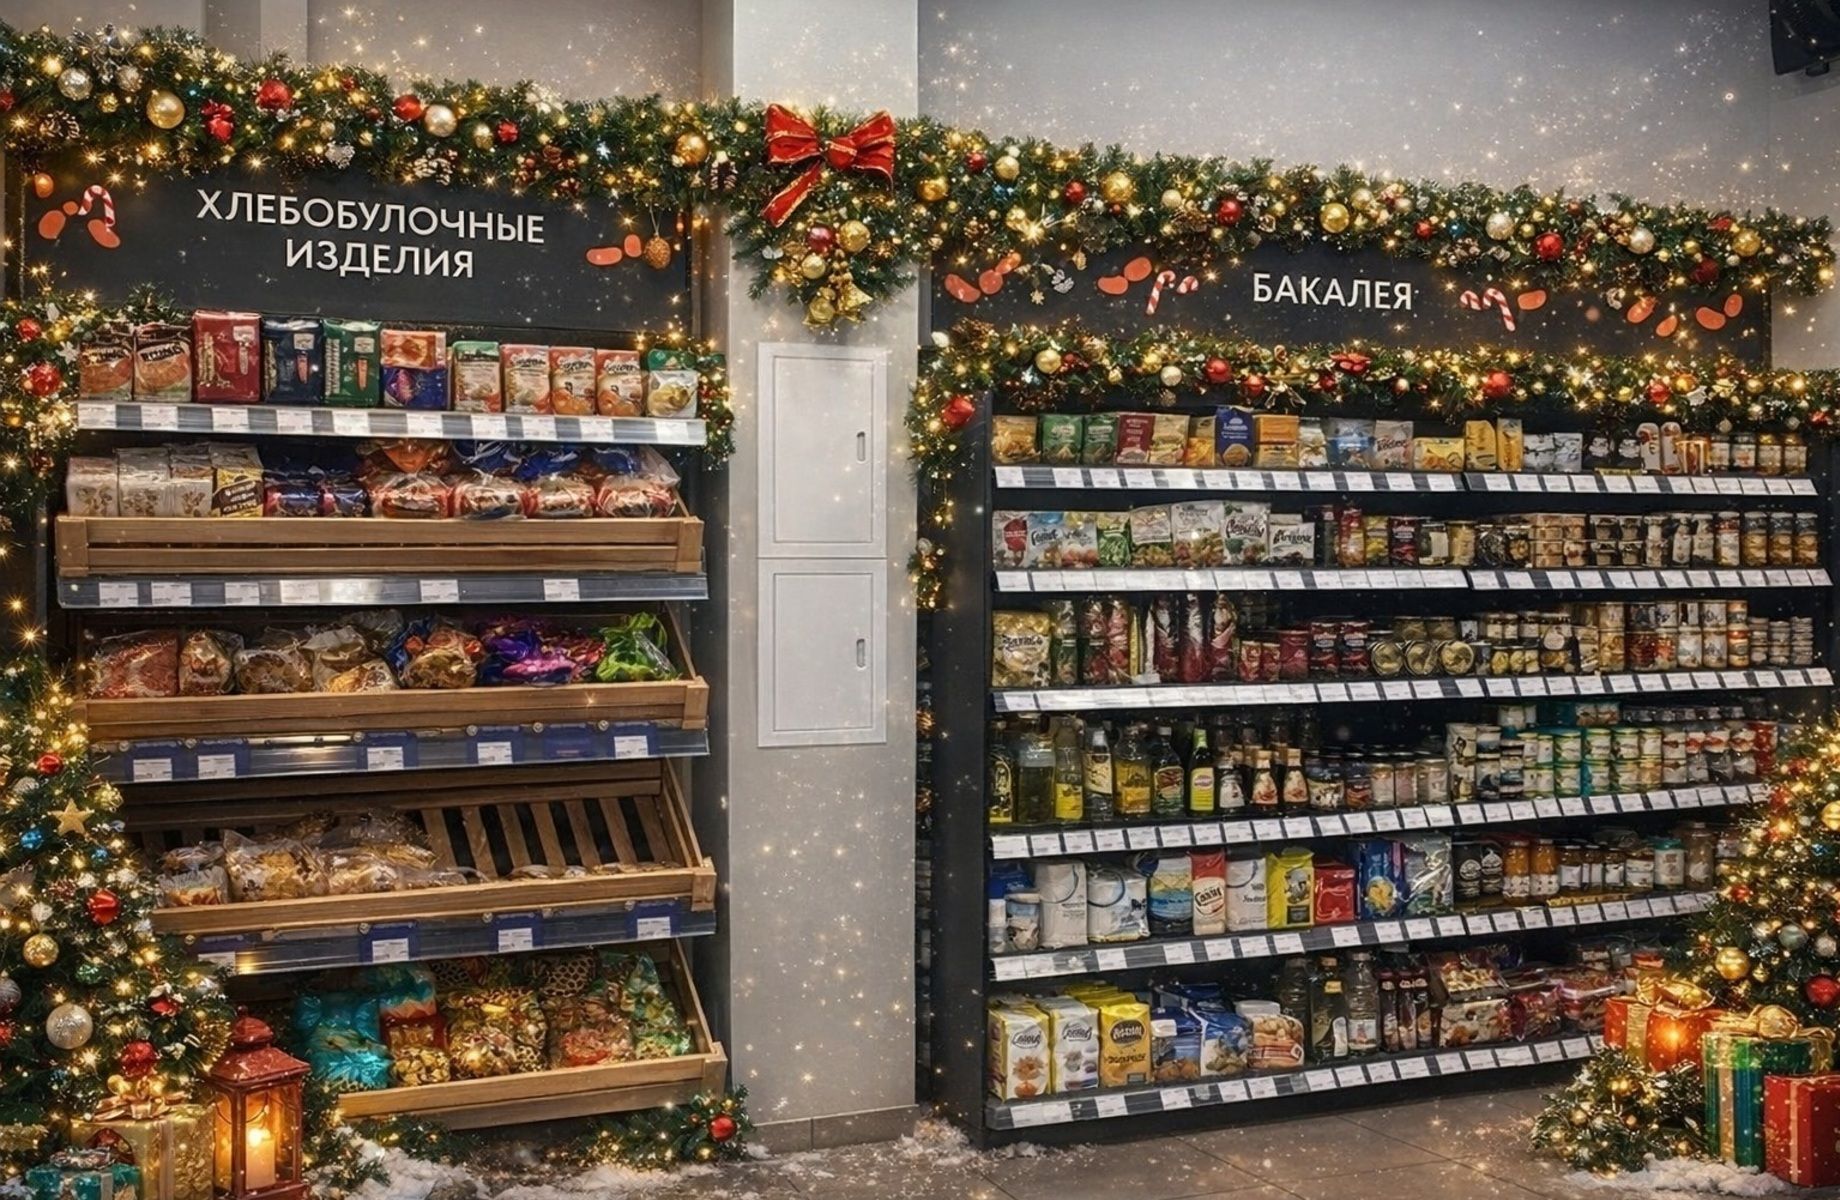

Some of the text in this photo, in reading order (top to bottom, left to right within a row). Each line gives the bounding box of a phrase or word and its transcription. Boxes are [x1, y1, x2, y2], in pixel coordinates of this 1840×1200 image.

[197, 189, 545, 244] ХЛЕБОБУЛОЧНЫЕ
[285, 238, 474, 279] ИЗДЕЛИЯ
[1253, 273, 1412, 310] БАКАЛЕЯ
